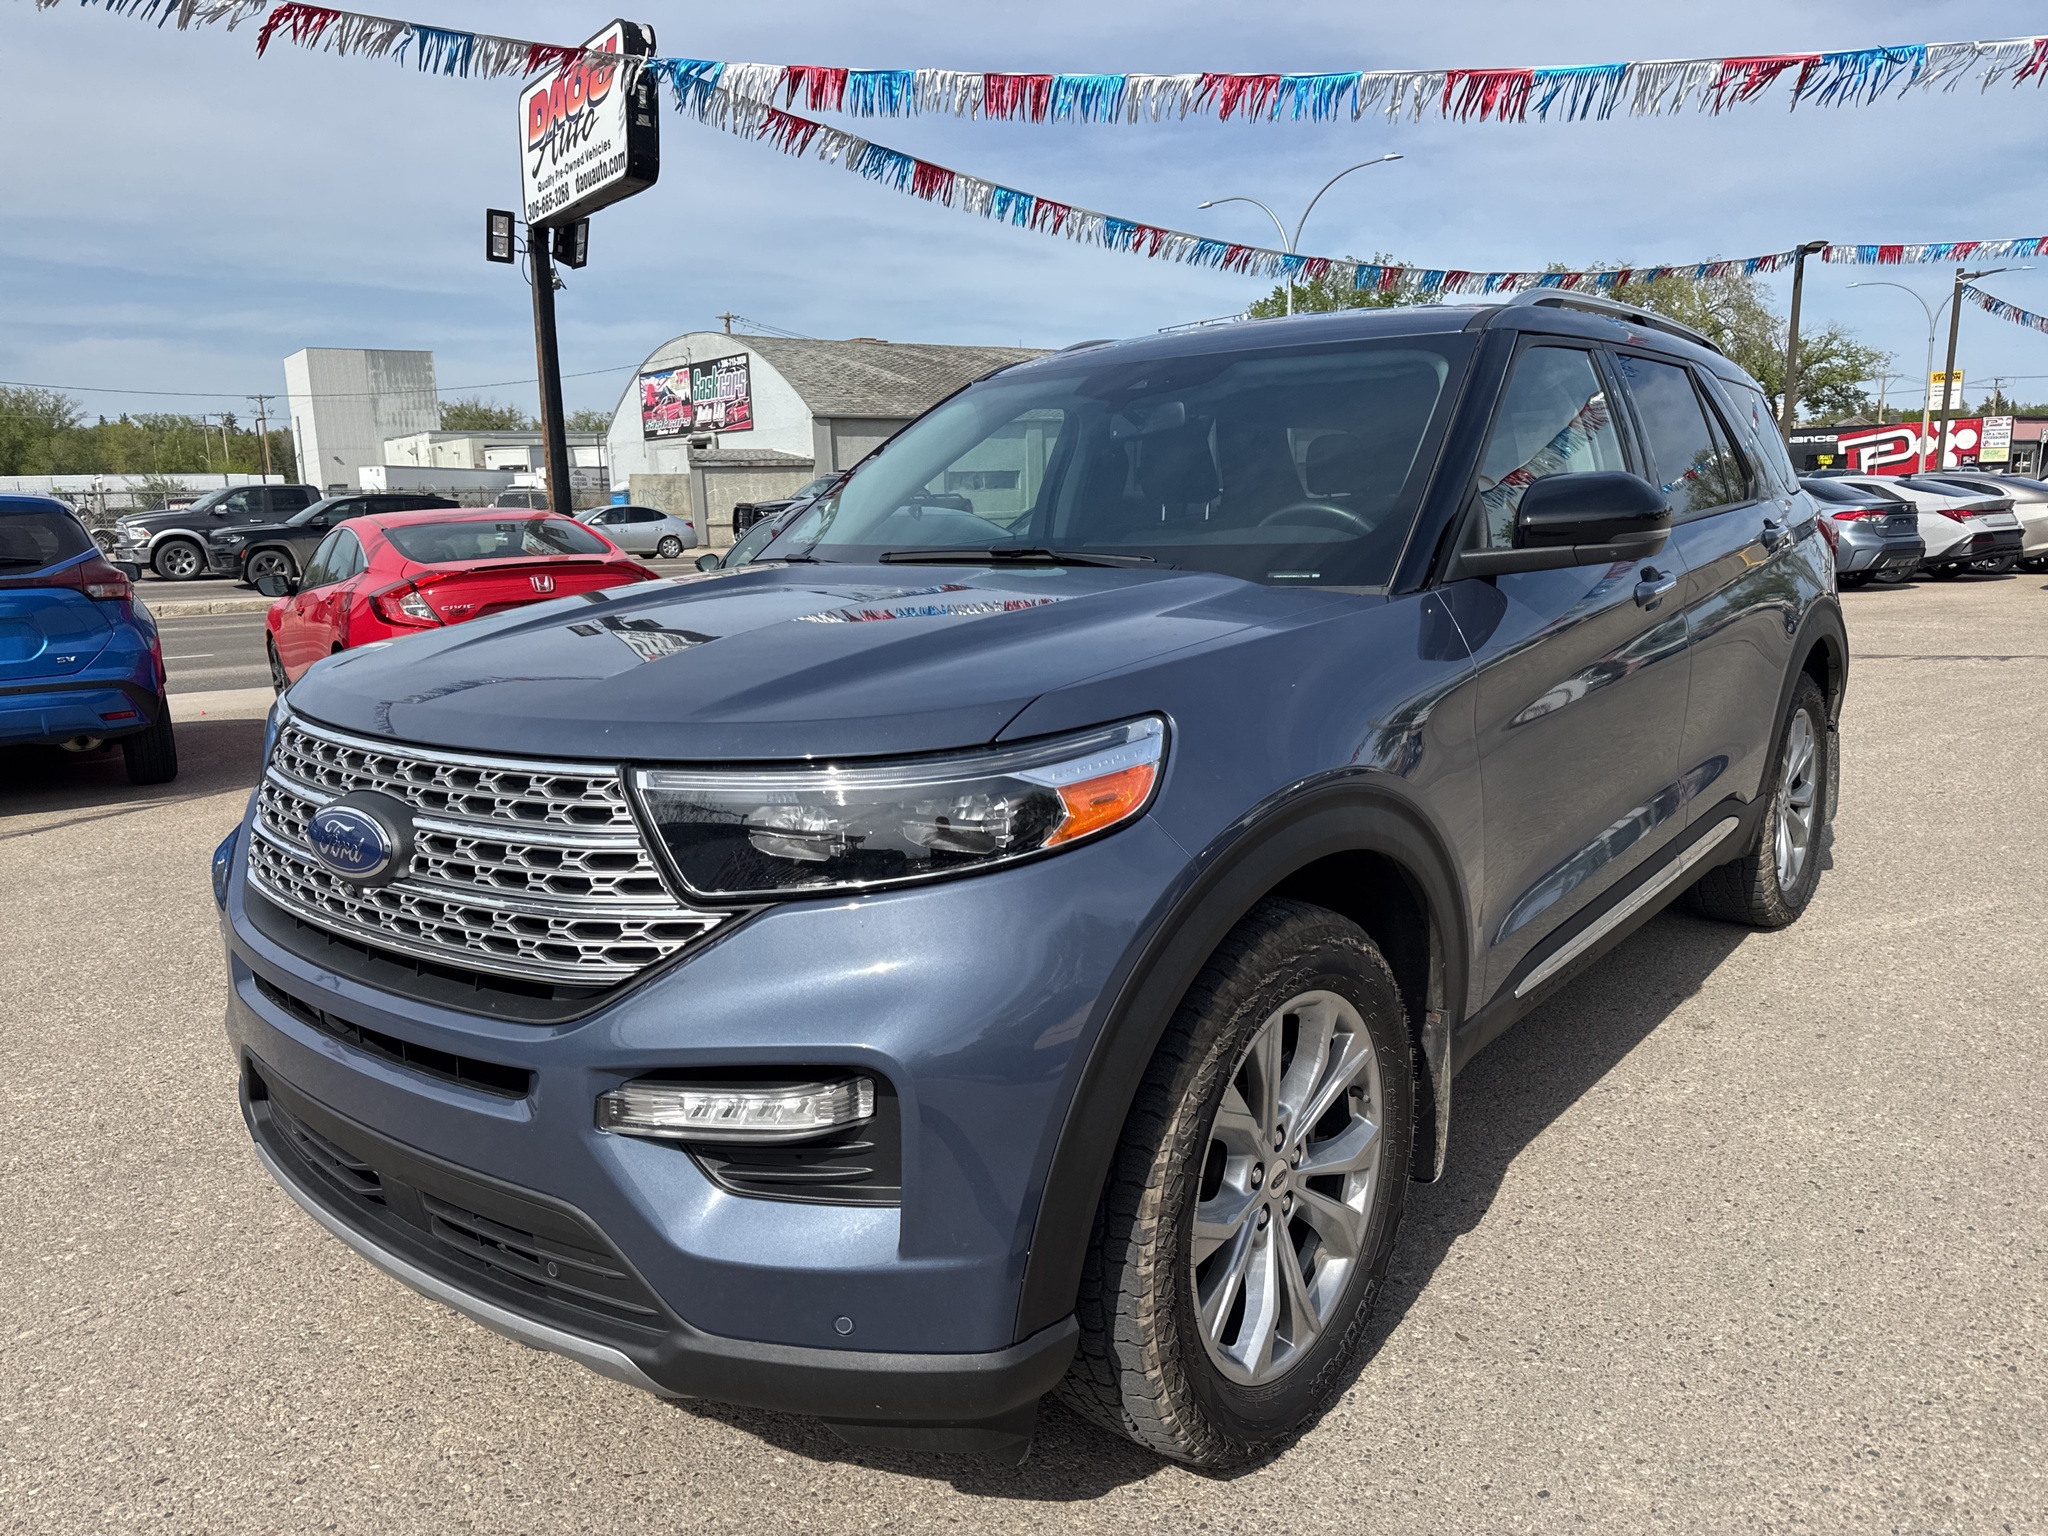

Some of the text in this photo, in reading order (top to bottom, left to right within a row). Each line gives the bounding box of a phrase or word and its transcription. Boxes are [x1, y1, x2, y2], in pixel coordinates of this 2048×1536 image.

[532, 104, 600, 179] Auto
[537, 139, 612, 193] Quality Pre-Owned Vehicles
[528, 151, 626, 222] 306-665-3268 daouauto.com
[440, 603, 475, 611] CIVIC
[56, 655, 76, 664] SV
[320, 819, 365, 864] Ford
